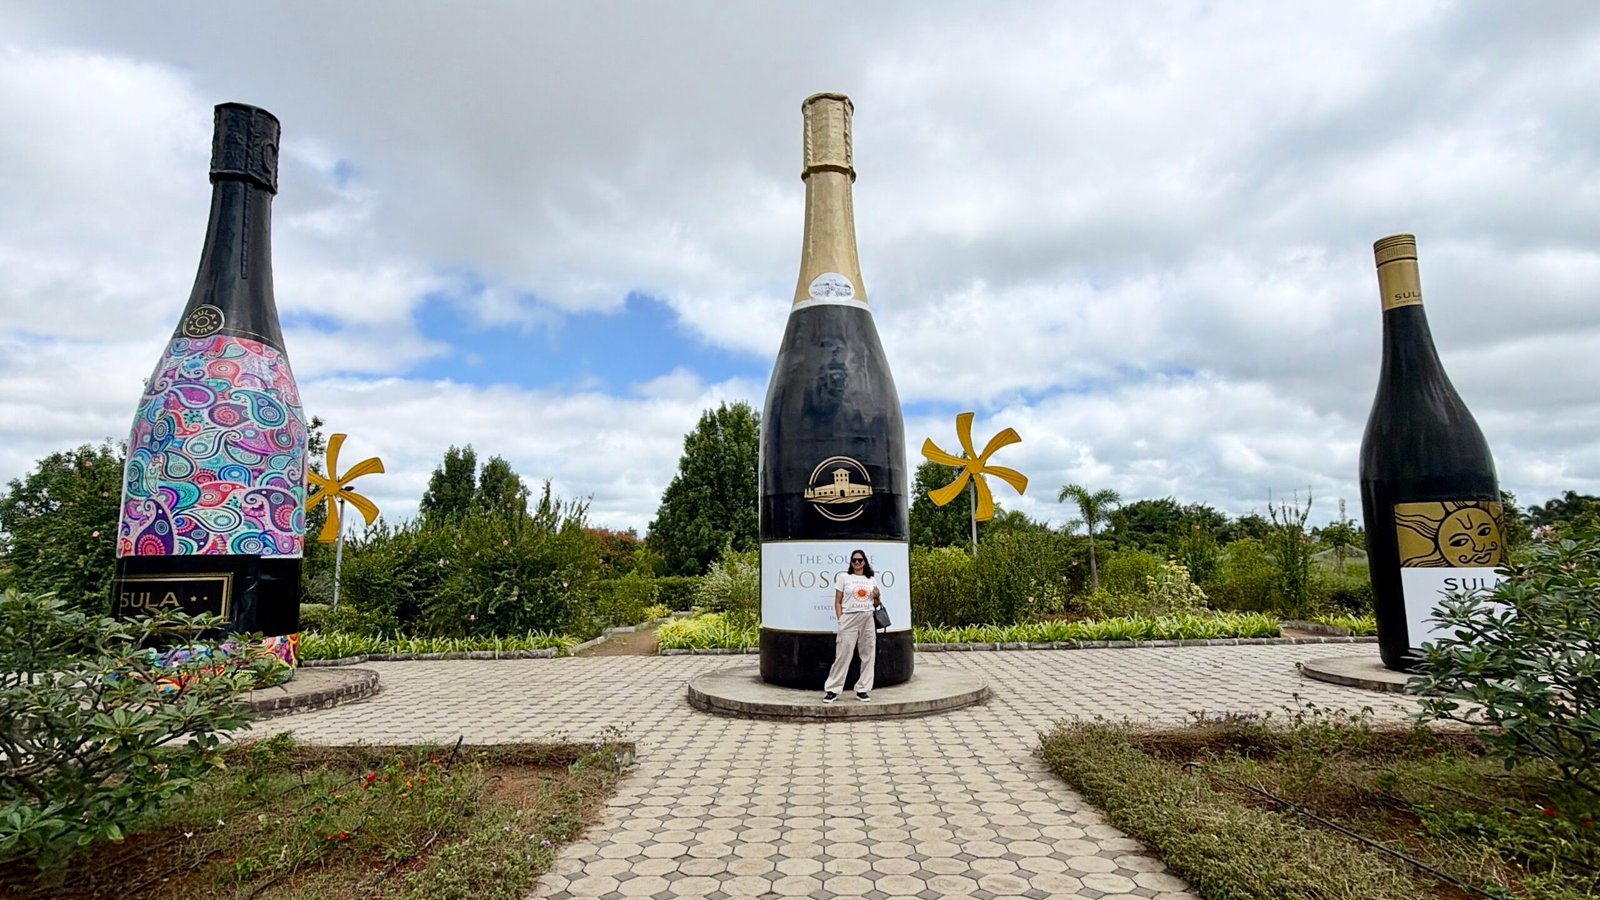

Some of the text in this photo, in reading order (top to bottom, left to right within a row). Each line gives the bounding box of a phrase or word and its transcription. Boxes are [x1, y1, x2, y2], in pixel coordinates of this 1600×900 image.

[1394, 291, 1421, 300] SUL
[192, 309, 217, 319] SULA
[797, 553, 876, 565] THE SOUE
